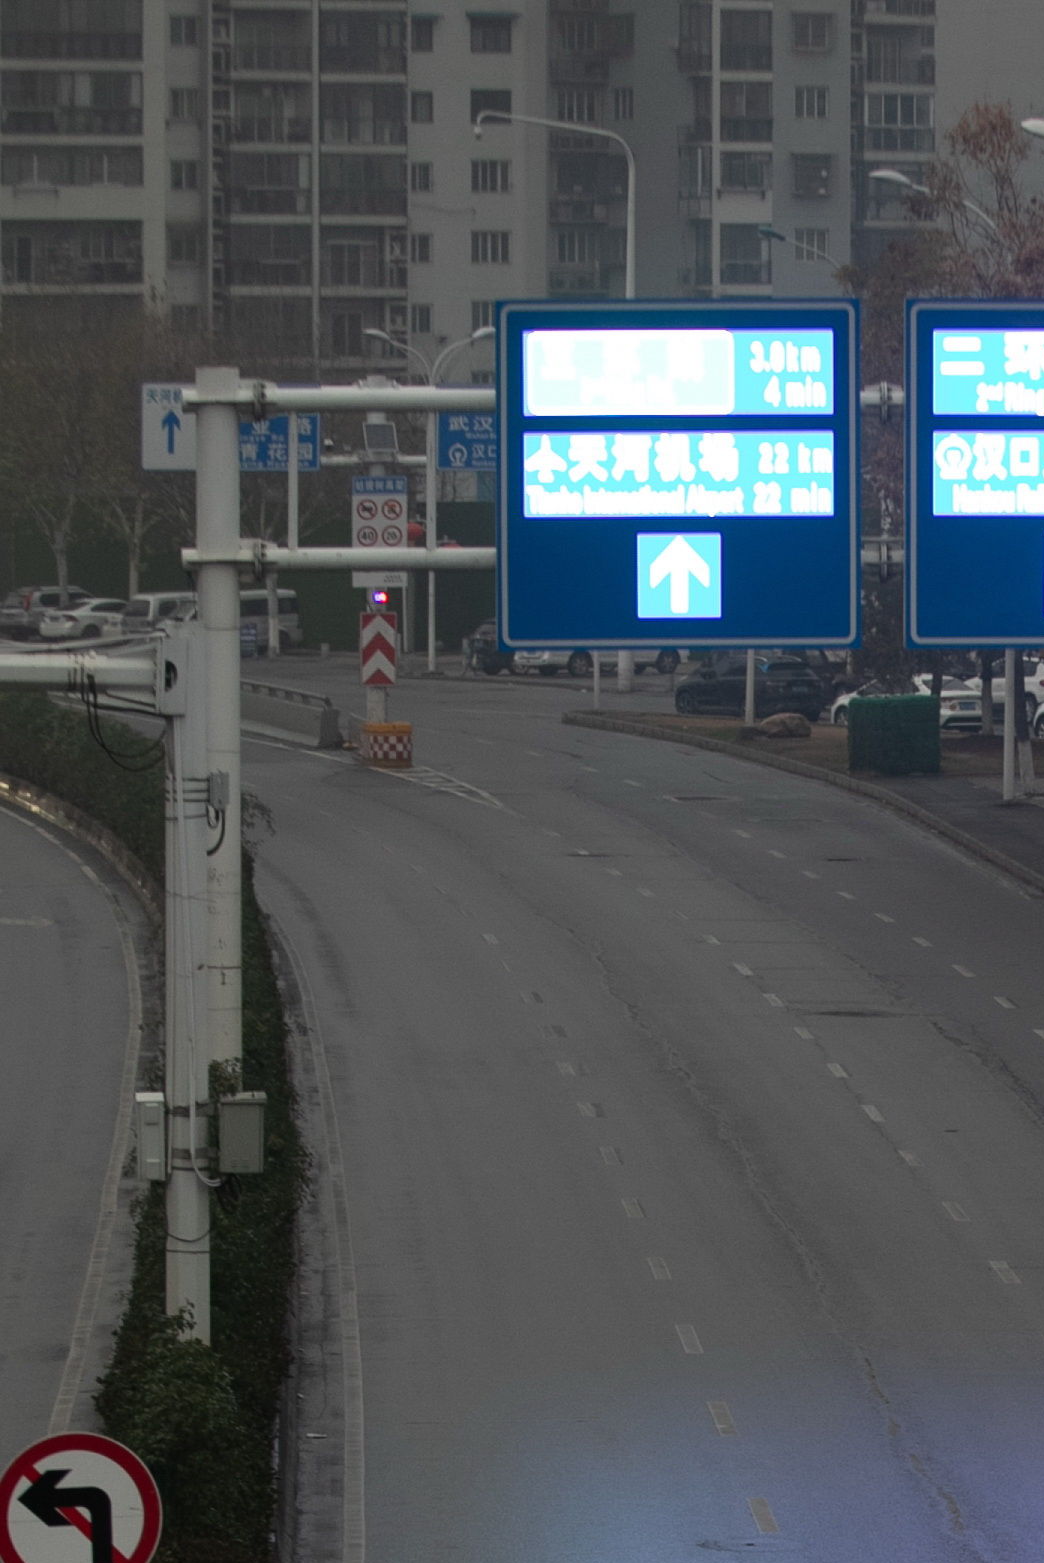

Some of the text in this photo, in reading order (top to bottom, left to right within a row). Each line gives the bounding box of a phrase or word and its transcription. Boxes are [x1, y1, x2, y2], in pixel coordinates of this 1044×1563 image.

[764, 376, 826, 407] 4 min
[569, 432, 738, 482] 天河机场
[798, 442, 832, 473] km
[791, 481, 832, 513] min
